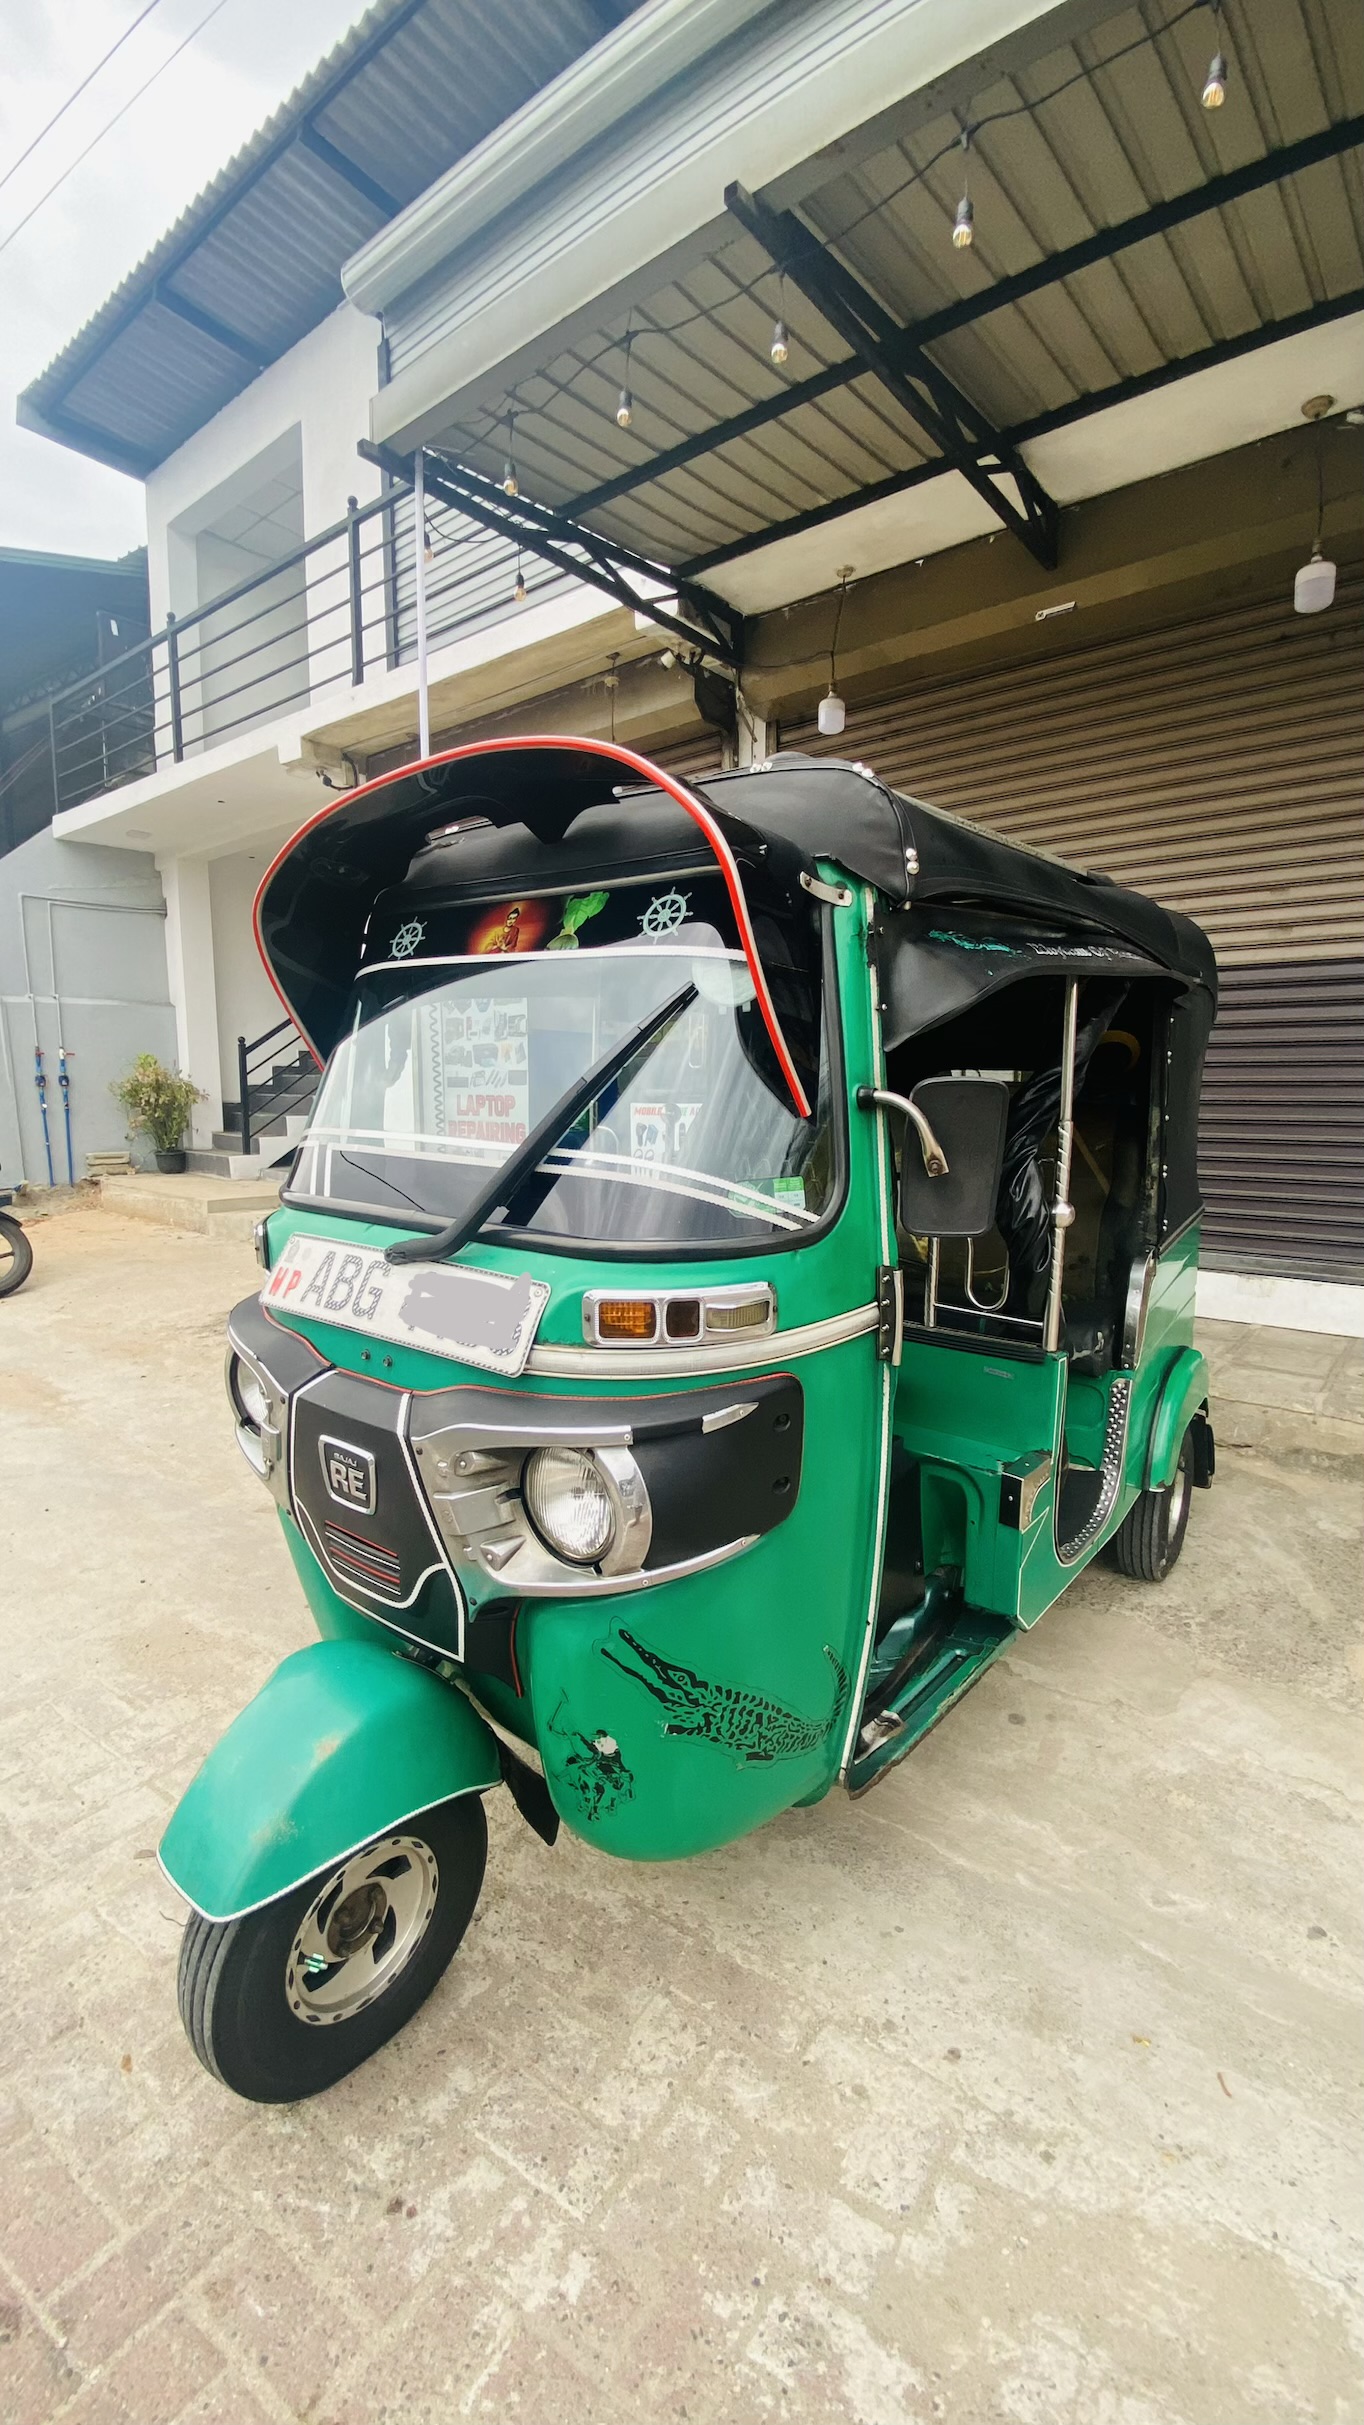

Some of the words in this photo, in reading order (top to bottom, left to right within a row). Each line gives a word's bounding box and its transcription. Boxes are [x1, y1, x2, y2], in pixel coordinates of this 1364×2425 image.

[456, 1094, 516, 1117] LAPTOP
[634, 1106, 663, 1116] MOBILE
[448, 1120, 526, 1145] REPAIRING
[268, 1266, 302, 1299] WP
[302, 1250, 391, 1320] ABG
[330, 1459, 367, 1501] RE
